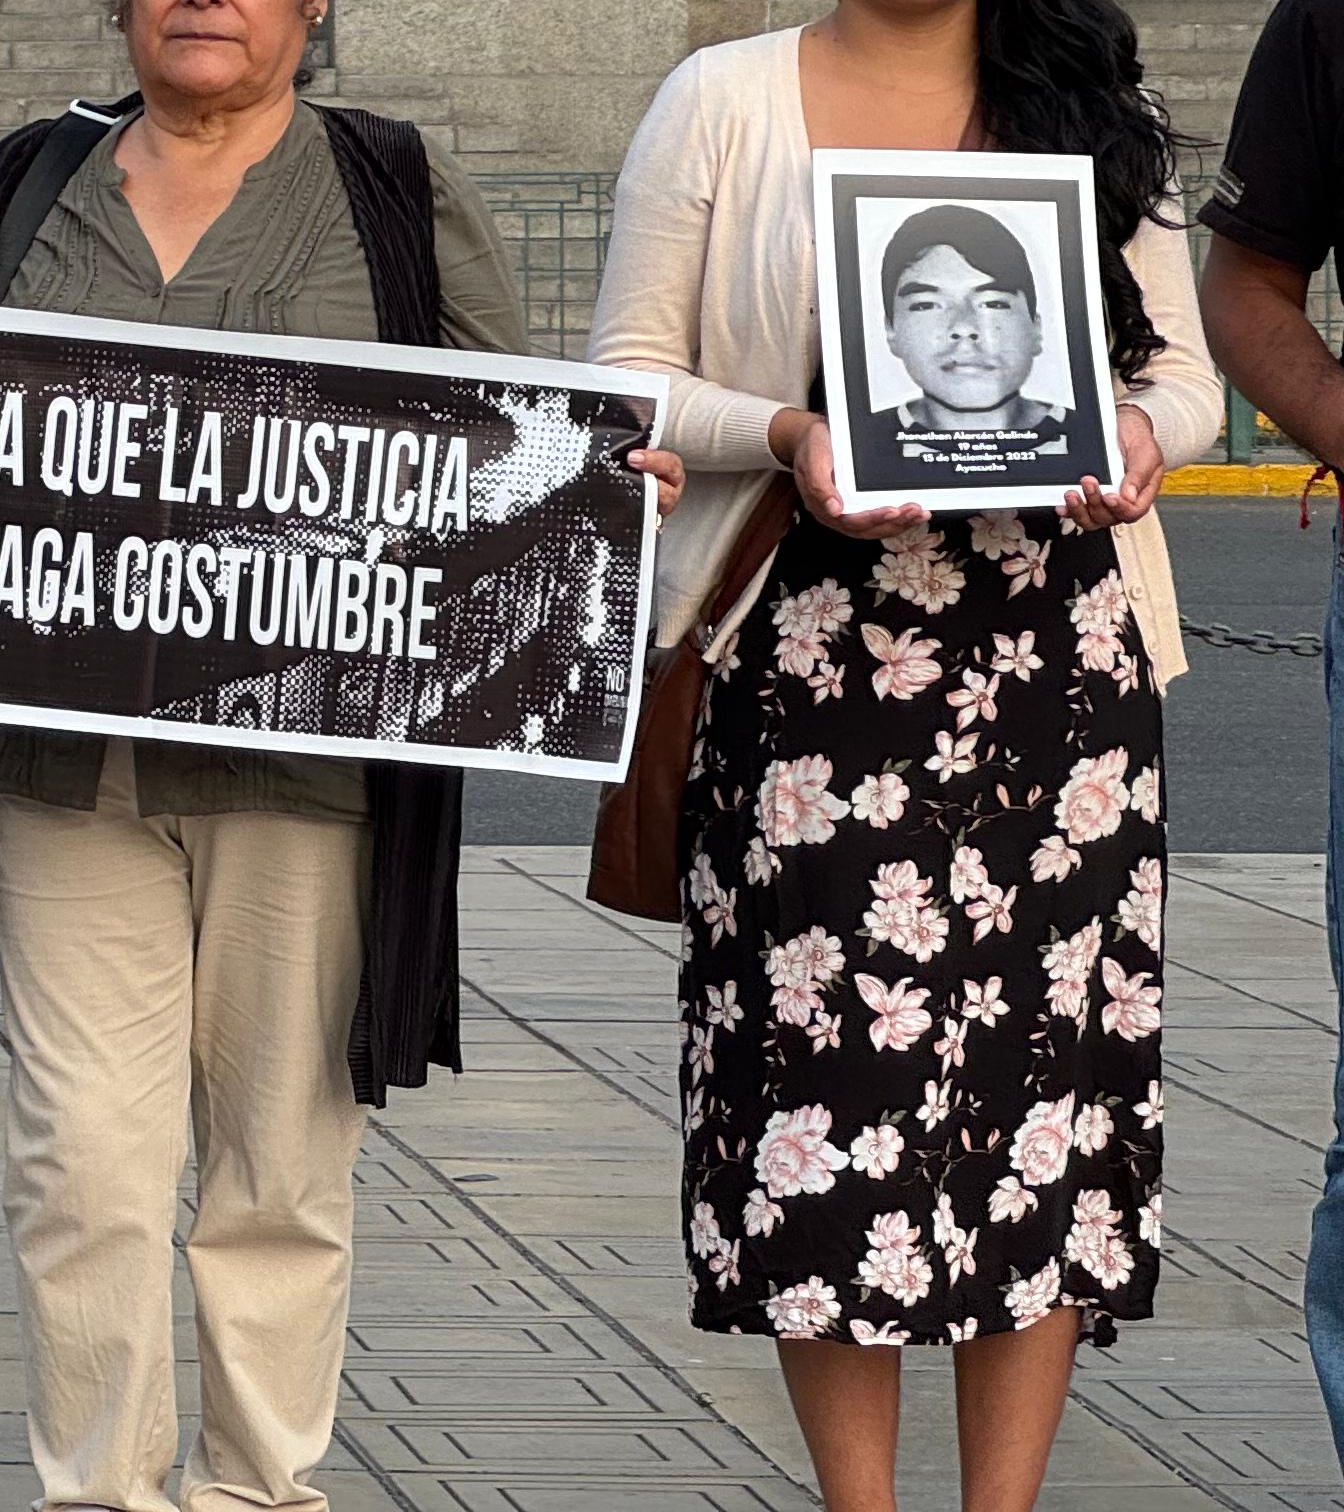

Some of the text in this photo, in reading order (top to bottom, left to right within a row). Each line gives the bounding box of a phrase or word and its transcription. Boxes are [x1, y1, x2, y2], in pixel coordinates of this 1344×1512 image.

[40, 395, 149, 498] QUE
[158, 406, 222, 507] LA
[237, 415, 469, 532] JUSTICIA
[114, 535, 444, 661] COSTUMBRE
[605, 665, 625, 693] NO
